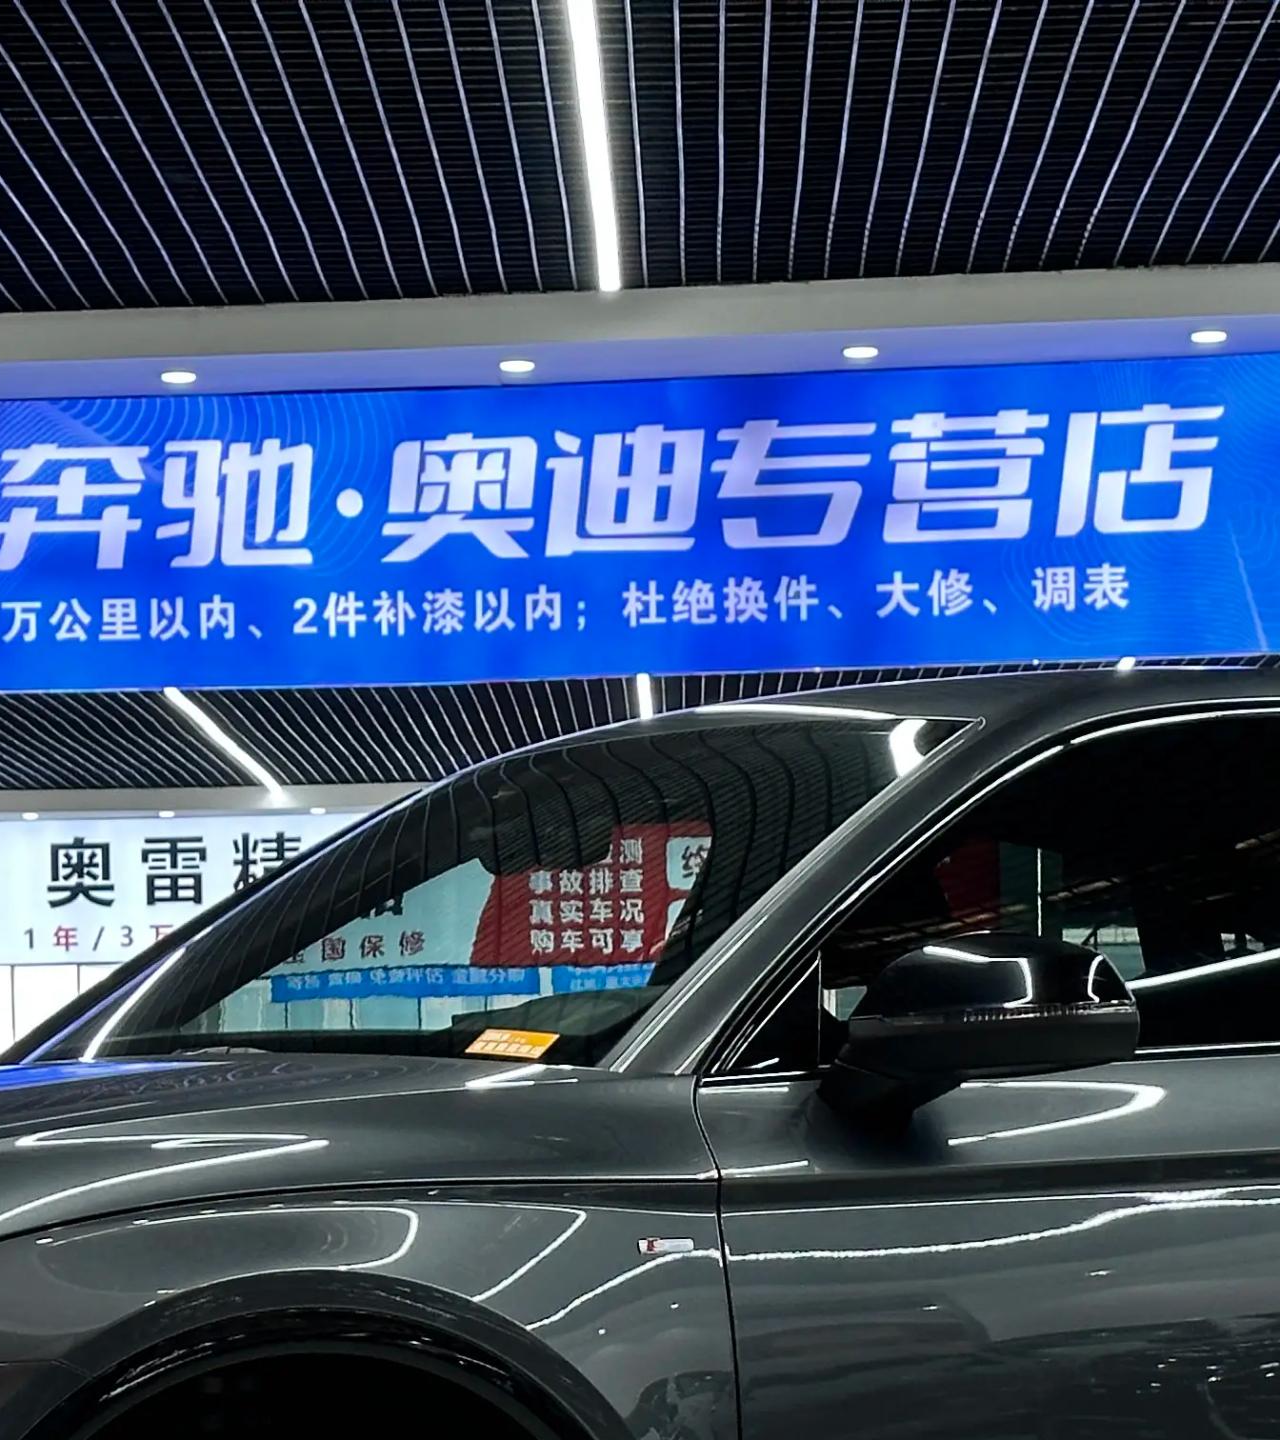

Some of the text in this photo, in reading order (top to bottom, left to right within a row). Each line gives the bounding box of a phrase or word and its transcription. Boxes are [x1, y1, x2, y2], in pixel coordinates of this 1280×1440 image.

[528, 868, 644, 895] 事故排查
[528, 898, 645, 925] 真实车况
[529, 927, 645, 956] 购车可享
